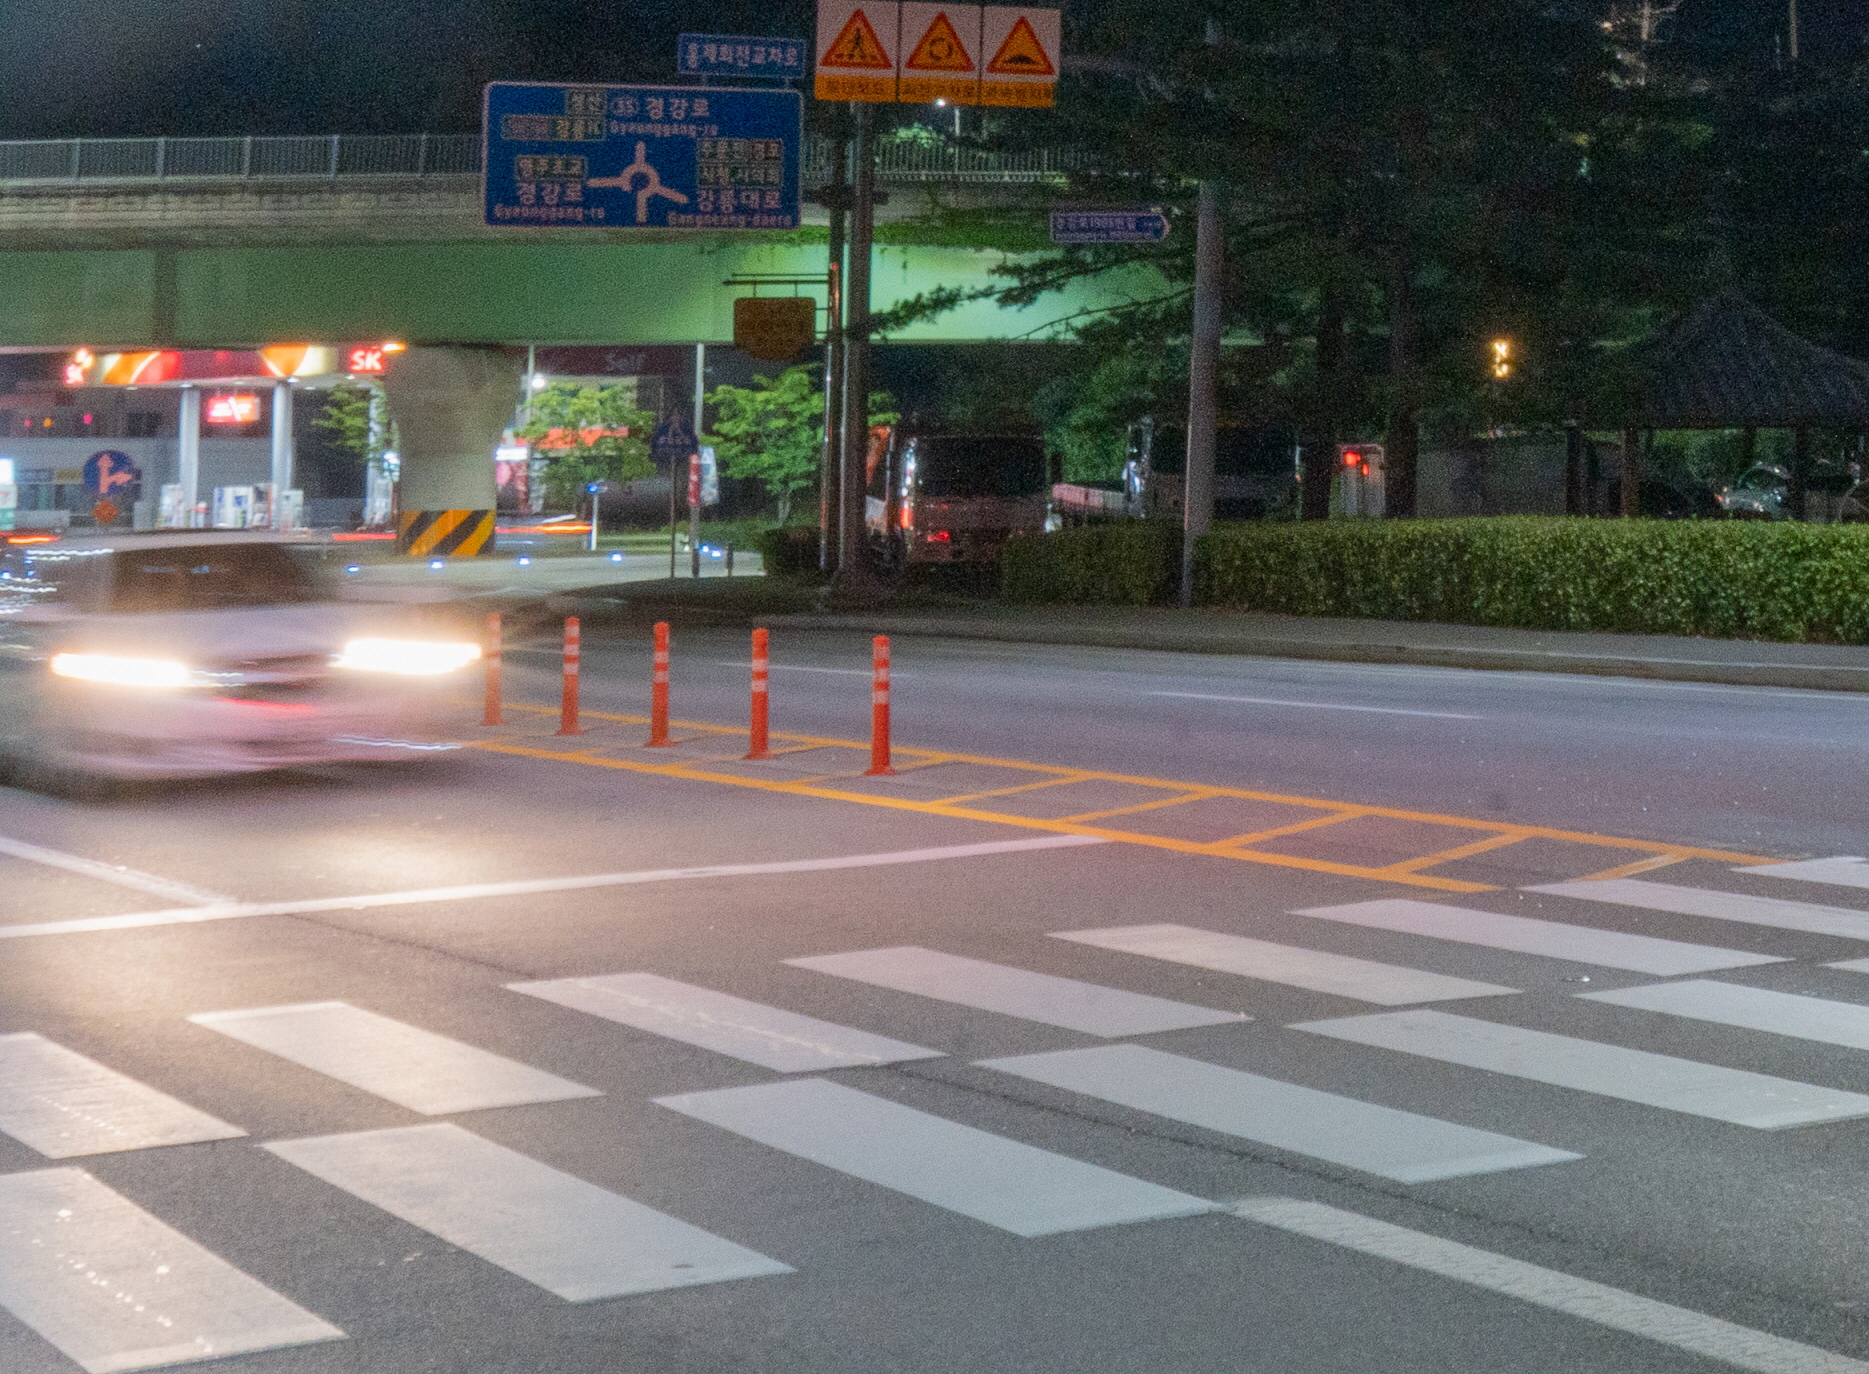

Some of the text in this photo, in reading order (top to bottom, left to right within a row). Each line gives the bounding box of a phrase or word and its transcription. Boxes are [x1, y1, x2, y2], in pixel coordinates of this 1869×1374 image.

[646, 96, 711, 120] 경강로
[516, 182, 585, 206] 경강로
[696, 190, 782, 213] 강릉대로
[351, 350, 382, 371] SK
